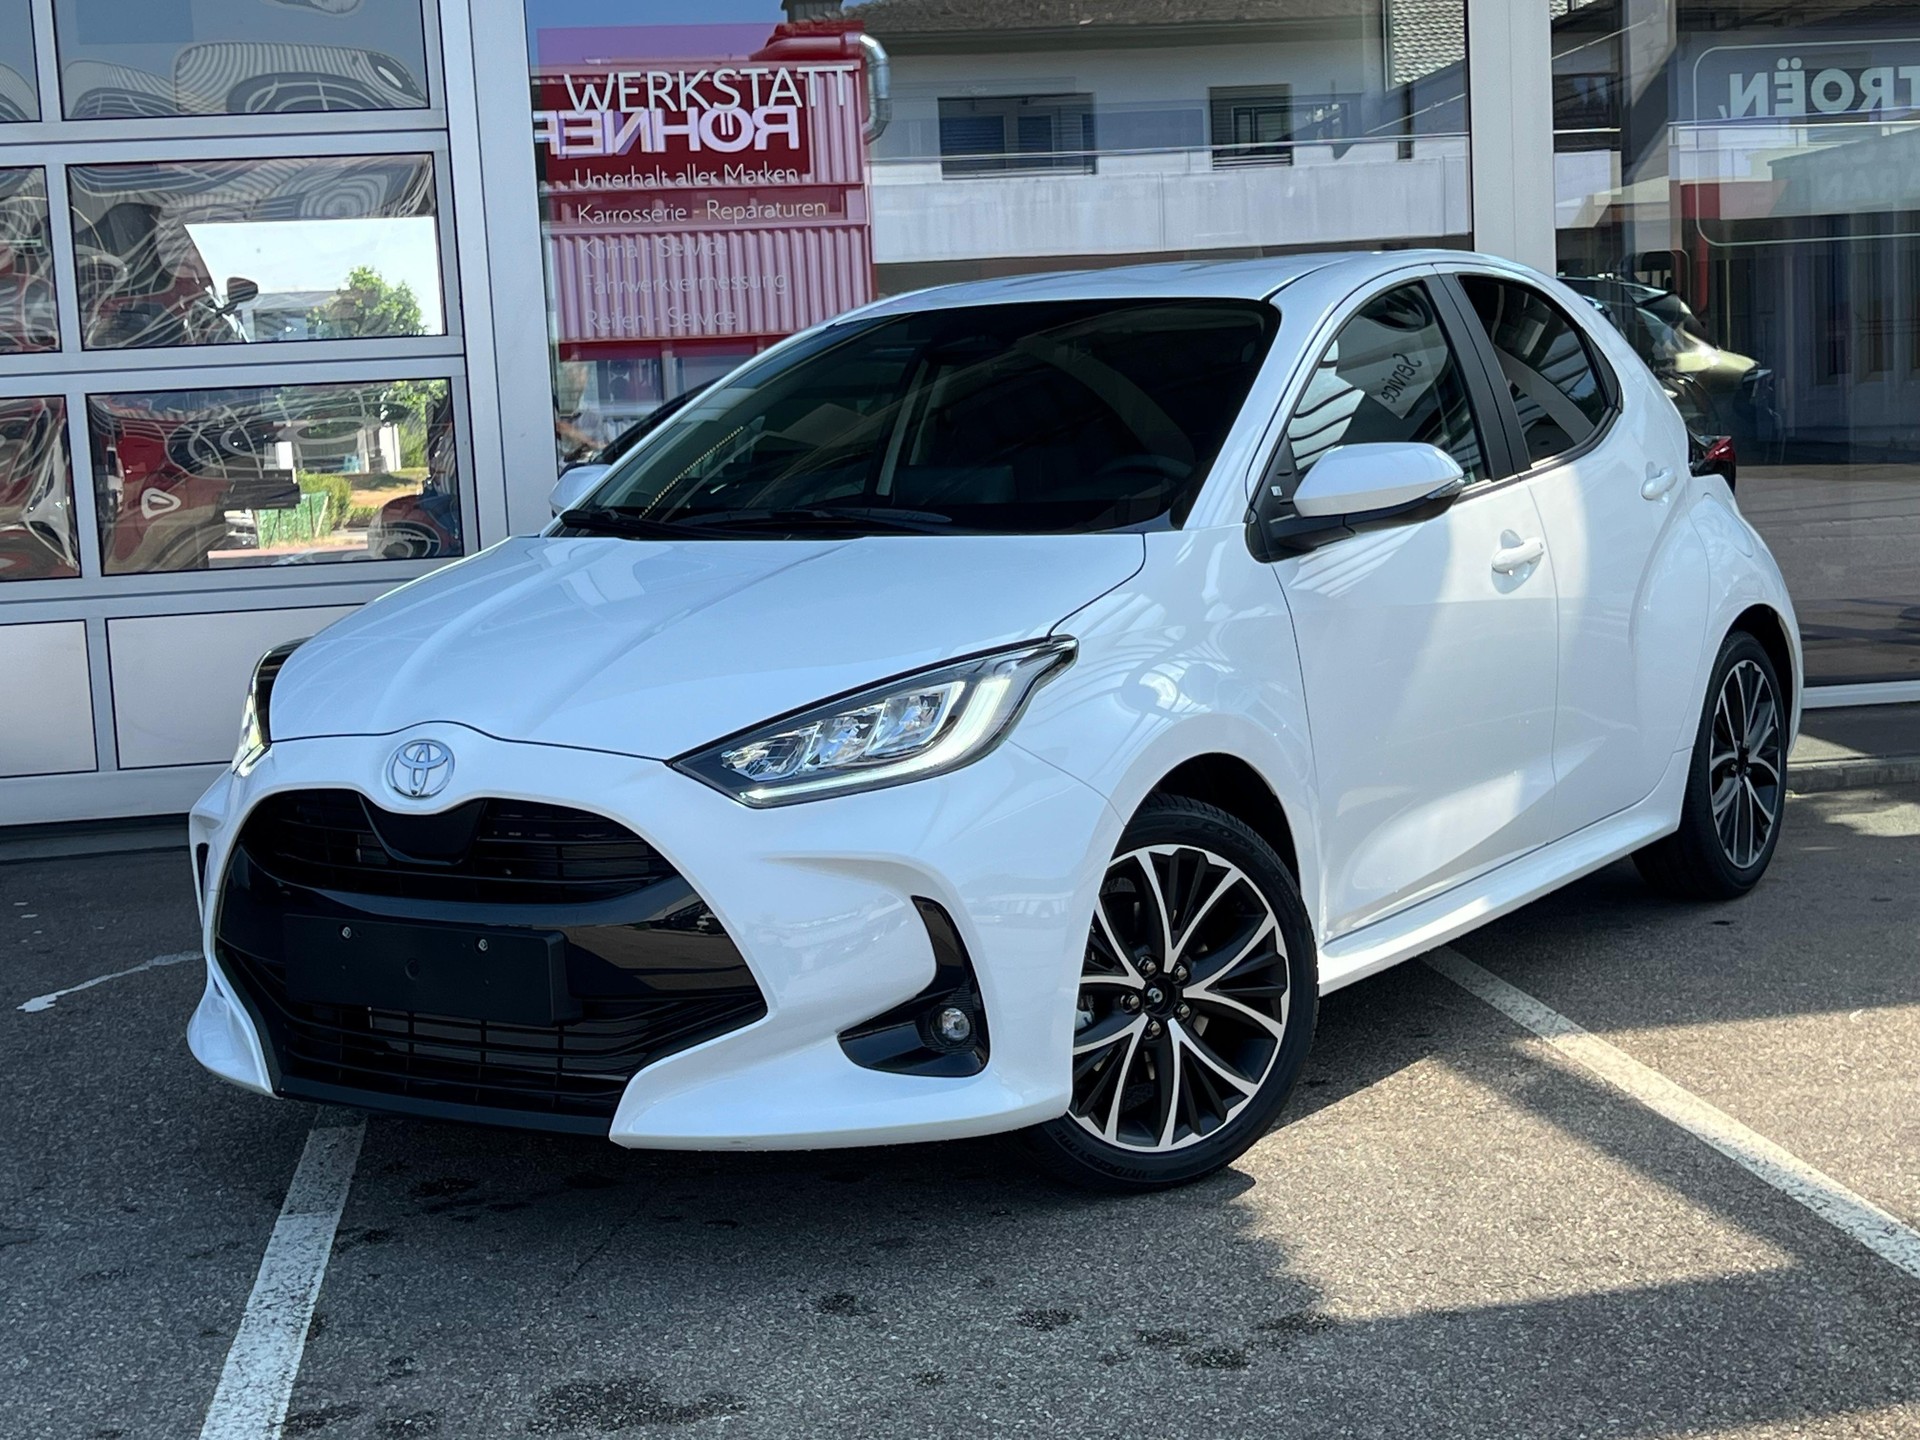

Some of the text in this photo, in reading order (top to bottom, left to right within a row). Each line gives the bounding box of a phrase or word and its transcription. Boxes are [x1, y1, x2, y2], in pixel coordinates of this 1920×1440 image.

[563, 65, 854, 115] WERKSTATT
[574, 161, 798, 190] Unterhalt aller Marken
[577, 203, 687, 225] Karrosserie
[706, 199, 826, 224] Reparaturen
[585, 307, 648, 331] Reifen
